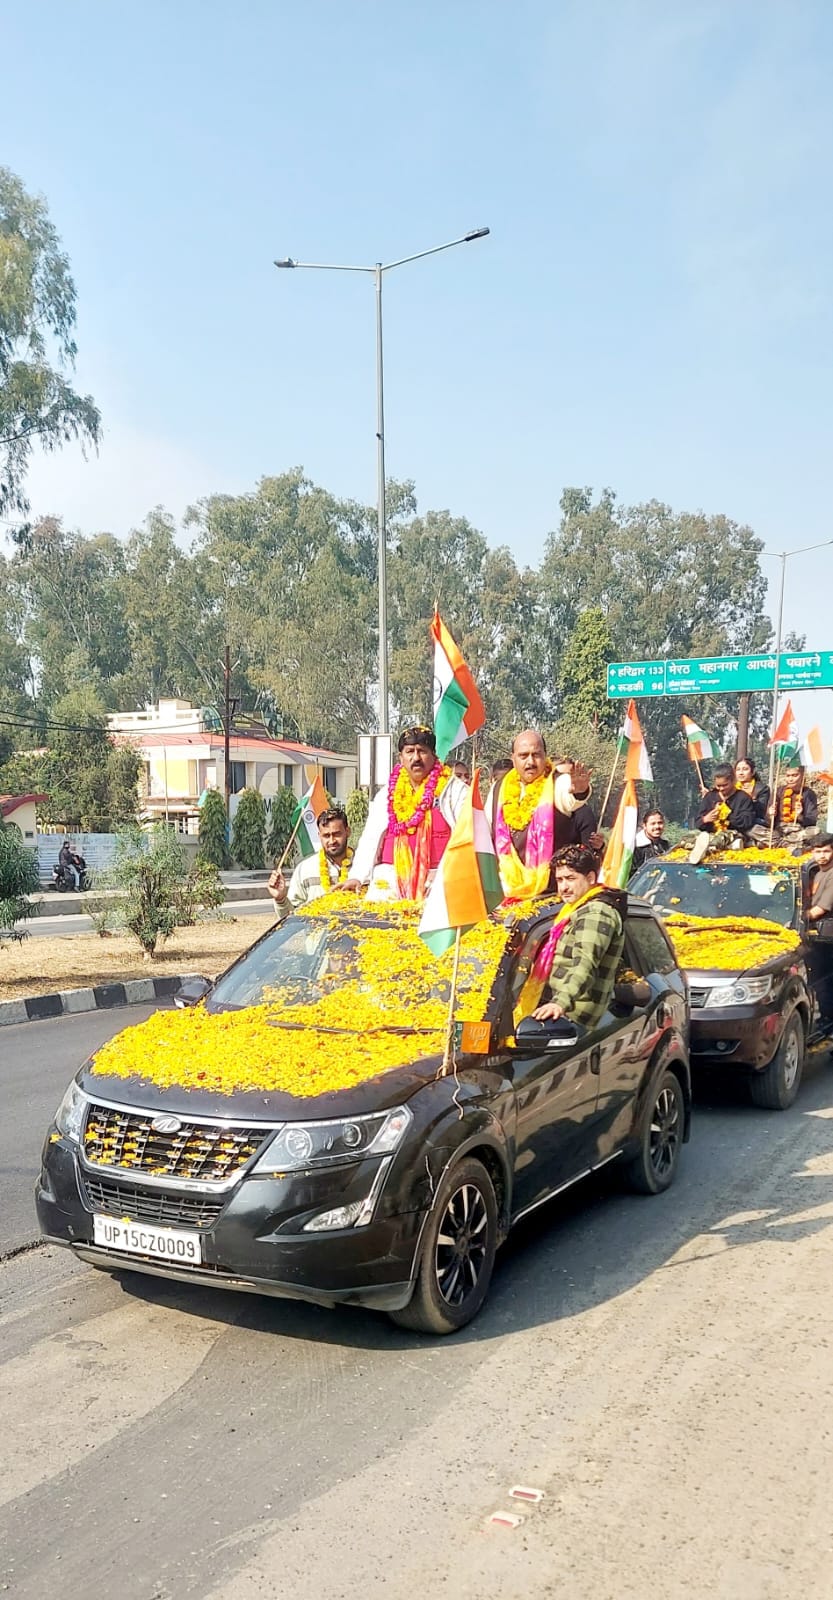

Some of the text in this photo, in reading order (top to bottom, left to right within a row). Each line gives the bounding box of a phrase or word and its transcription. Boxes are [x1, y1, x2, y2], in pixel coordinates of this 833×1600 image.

[618, 665, 664, 677] हरिद्वार 133
[668, 662, 690, 674] मेरठ
[698, 661, 739, 674] महानगर
[651, 682, 663, 691] 96
[104, 1225, 195, 1258] UP15CZ0009
